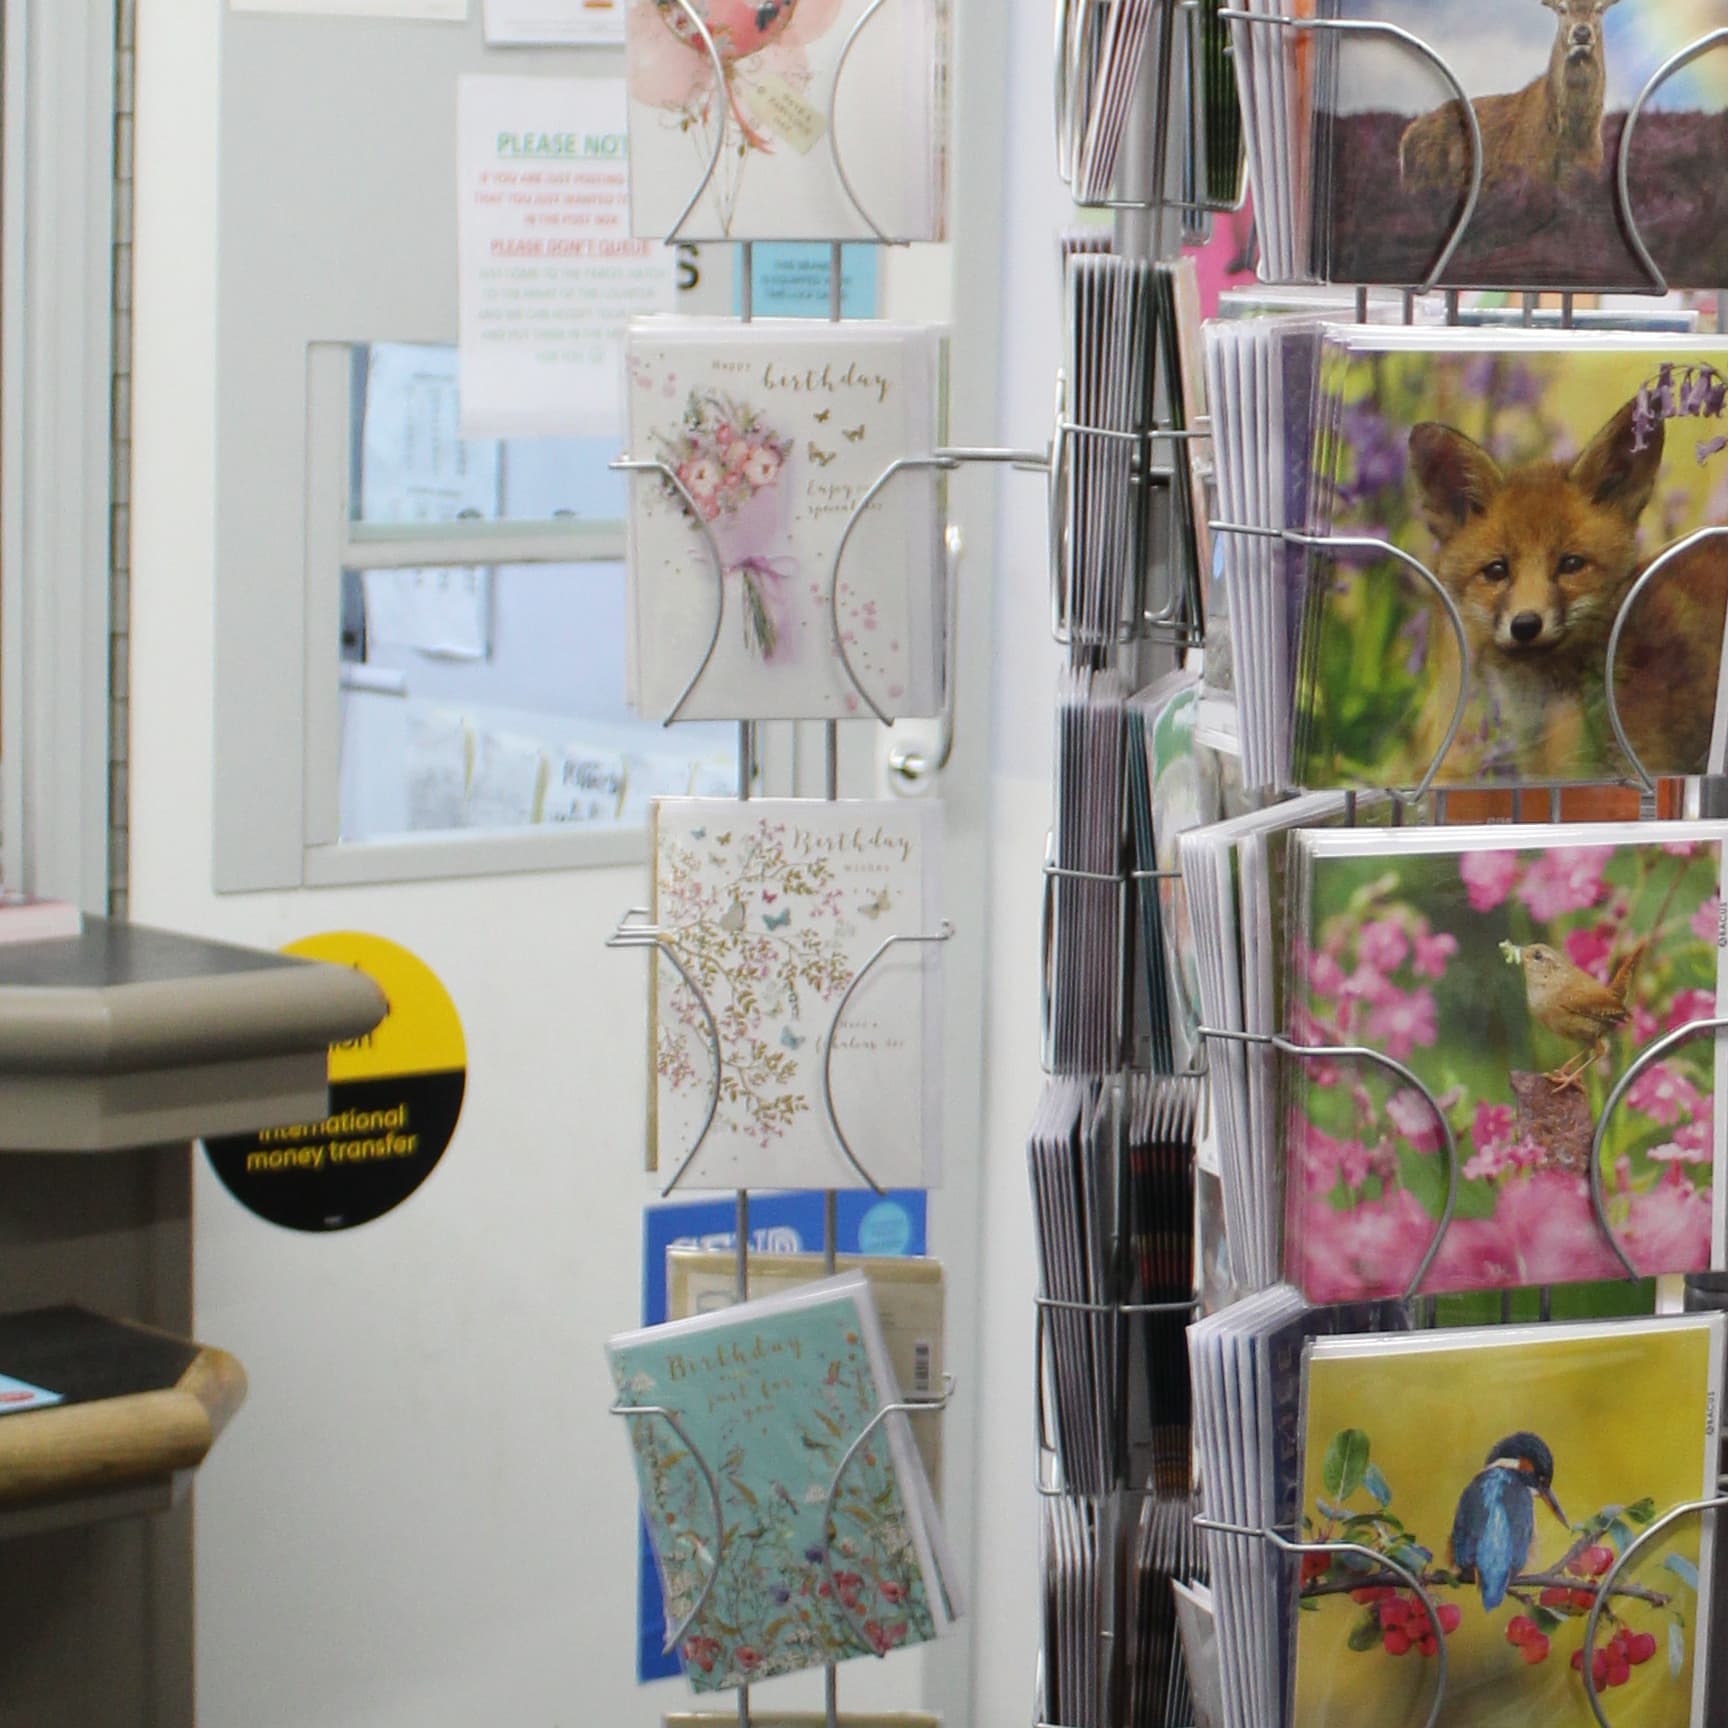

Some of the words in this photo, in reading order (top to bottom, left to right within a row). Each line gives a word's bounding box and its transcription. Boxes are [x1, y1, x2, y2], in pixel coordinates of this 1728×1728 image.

[497, 133, 575, 154] PLEASE
[491, 239, 543, 257] PLEASE
[547, 239, 593, 257] DON'T
[599, 239, 652, 257] QUEUE
[763, 363, 890, 403] birthday
[794, 825, 912, 862] Birthday
[247, 1144, 324, 1171] money
[329, 1132, 416, 1161] transfer
[666, 1332, 803, 1381] Birthday
